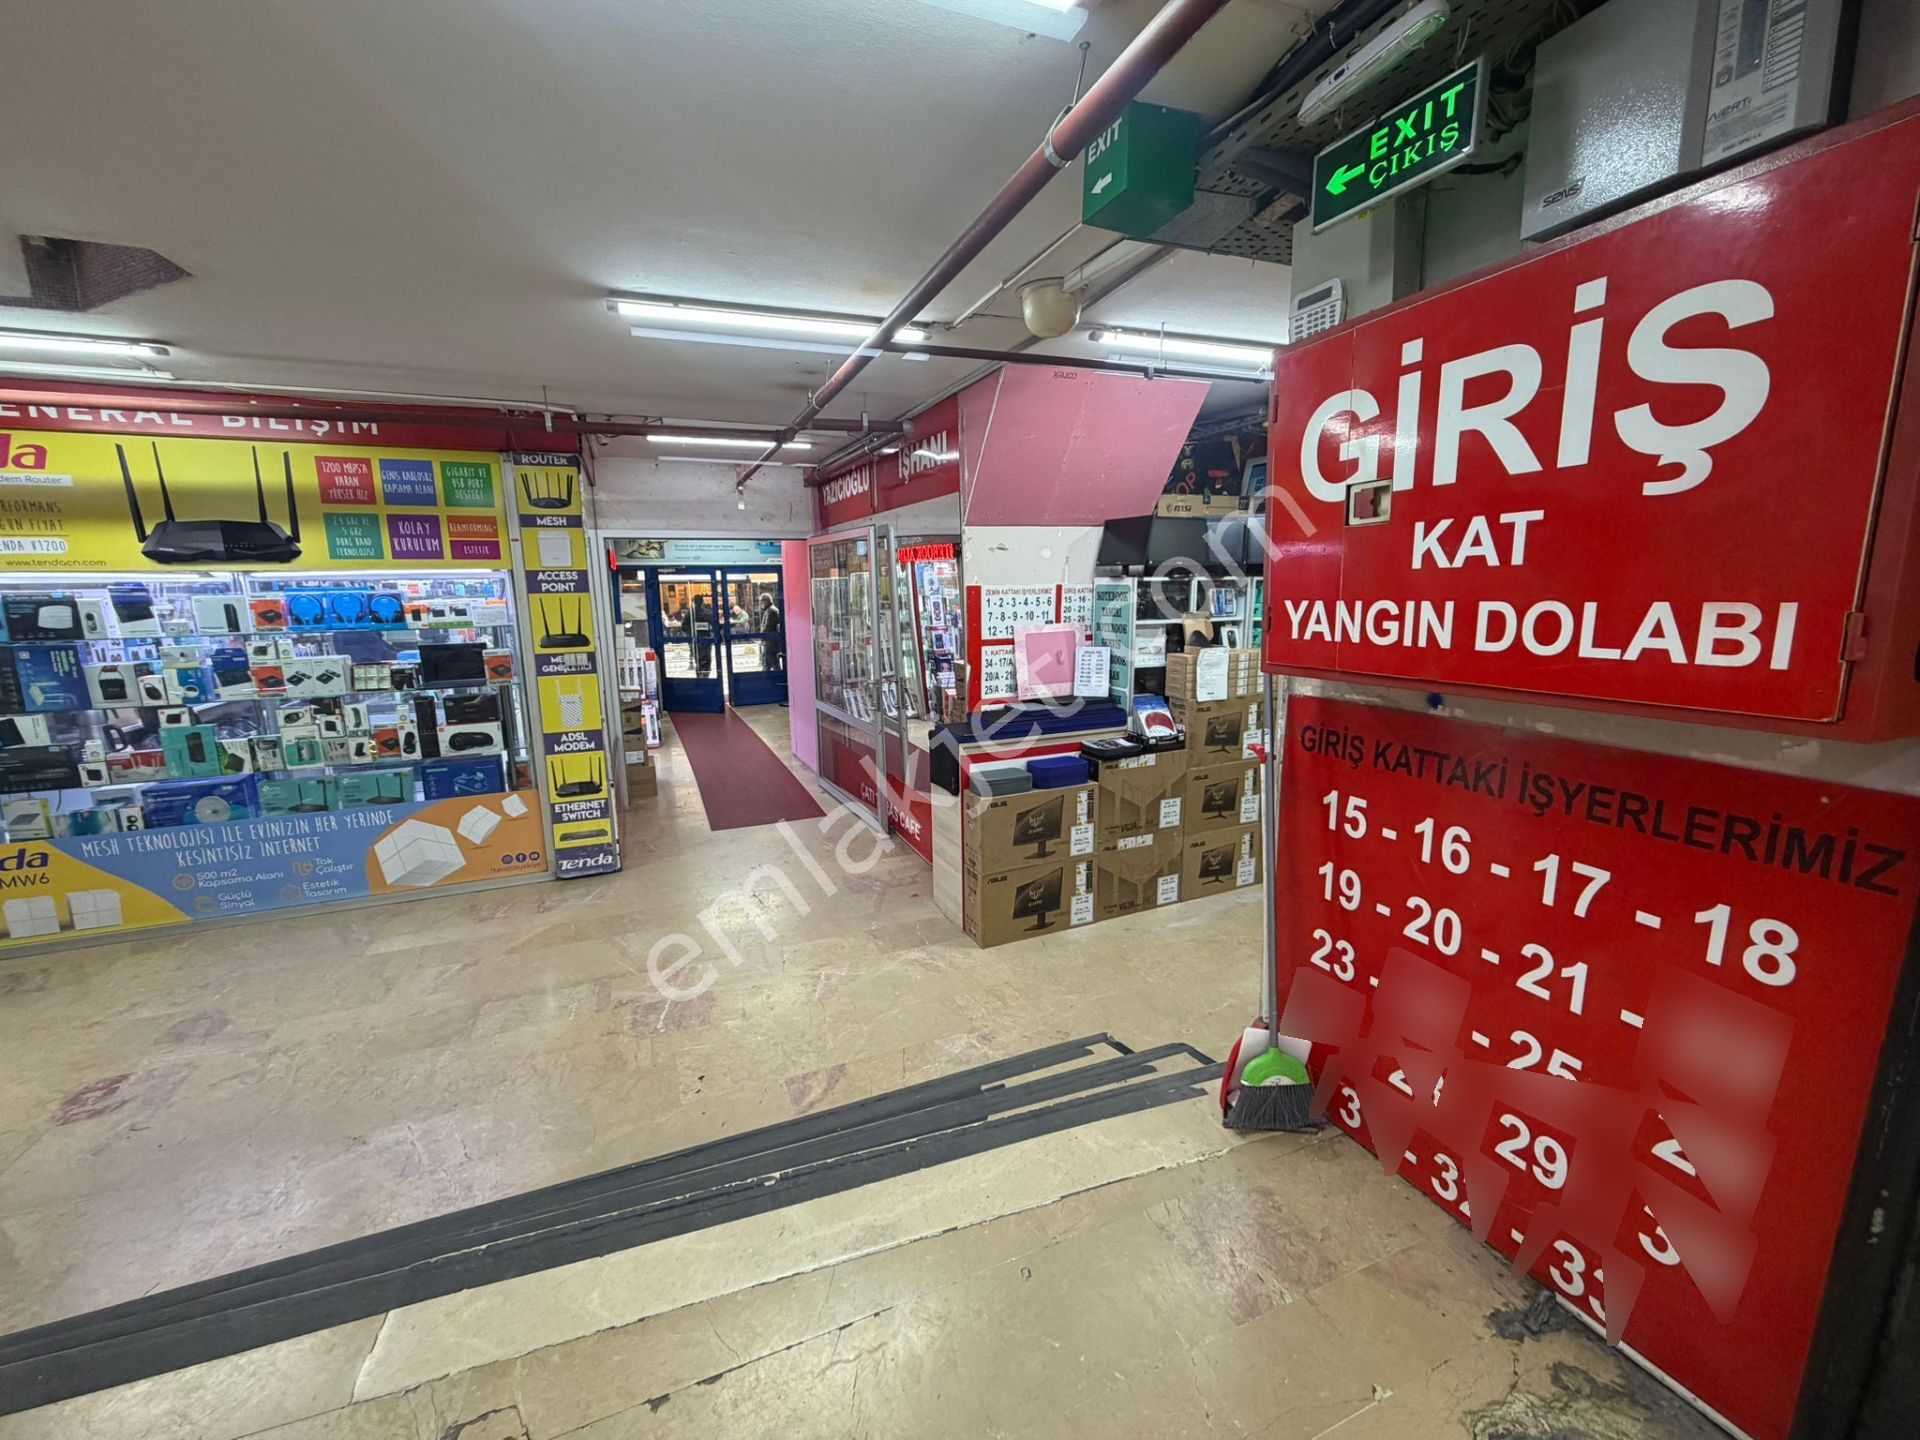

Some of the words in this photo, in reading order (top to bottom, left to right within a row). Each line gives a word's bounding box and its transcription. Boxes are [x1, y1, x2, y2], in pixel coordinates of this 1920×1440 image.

[1370, 82, 1465, 161] EXIT
[1087, 116, 1124, 167] EXIT
[1368, 121, 1460, 189] ÇIKIŞ
[1300, 276, 1775, 502] GİRİŞ
[521, 453, 568, 465] ROUTER
[320, 461, 341, 473] 1200
[25, 474, 63, 484] Router
[821, 464, 870, 507] YAZICIOĞLU
[536, 516, 567, 526] MESH
[398, 520, 431, 535] KOLAY
[393, 537, 440, 552] KURULUM
[1411, 509, 1546, 570] KAT
[31, 540, 67, 552] V1200
[5, 558, 108, 568] www.tendacn.com
[537, 571, 578, 581] ACCESS
[541, 582, 577, 592] POINT
[999, 597, 1004, 608] 2
[1011, 597, 1016, 607] 3
[1023, 597, 1028, 607] 4
[1035, 596, 1040, 607] 5
[1047, 596, 1052, 606] 6
[988, 612, 993, 622] 7
[1000, 612, 1006, 622] 8
[1012, 611, 1018, 621] 9
[1025, 611, 1034, 621] 10
[1041, 610, 1050, 620] 11
[987, 626, 997, 636] 12
[1005, 625, 1015, 636] 13
[1284, 600, 1455, 650] YANGIN
[1475, 601, 1799, 671] DOLABI
[985, 658, 993, 668] 34
[999, 657, 1013, 667] 17/A
[984, 684, 999, 695] 25/A
[560, 731, 588, 742] ADSL
[554, 740, 595, 752] MODEM
[554, 799, 607, 813] ETHERNET
[1301, 722, 1365, 769] GİRİŞ
[1373, 739, 1508, 799] KATTAKİ
[1518, 761, 1907, 896] İŞYERLERİMİZ
[562, 810, 601, 821] SWITCH
[900, 812, 922, 841] CAFE
[81, 838, 120, 858] MESH
[126, 827, 215, 853] TEKNOLOJİSİ
[222, 825, 244, 843] İLE
[251, 817, 310, 838] EVİNİZİN
[315, 814, 338, 833] HER
[344, 809, 395, 829] YERİNDE
[175, 843, 253, 867] KESİNTİSİZ
[260, 836, 321, 858] İNTERNET
[315, 857, 334, 866] Tak
[558, 852, 613, 870] Tenda
[197, 870, 218, 880] 500
[220, 868, 238, 878] m2
[315, 863, 354, 875] Çalıştır
[198, 875, 253, 888] Kapsama
[256, 871, 284, 881] Alanı
[302, 879, 339, 890] Estetik
[304, 887, 347, 898] Tasarım
[1323, 789, 1368, 839] 15
[1414, 816, 1471, 875] 16
[1533, 853, 1611, 919] 17
[1694, 902, 1800, 988] 18
[218, 890, 252, 902] Güçlü
[219, 899, 255, 910] Sinyal
[1318, 861, 1362, 911] 19
[1403, 896, 1462, 957] 20
[1516, 943, 1589, 1016] 21
[1310, 928, 1356, 983] 23
[1494, 1113, 1568, 1190] 29
